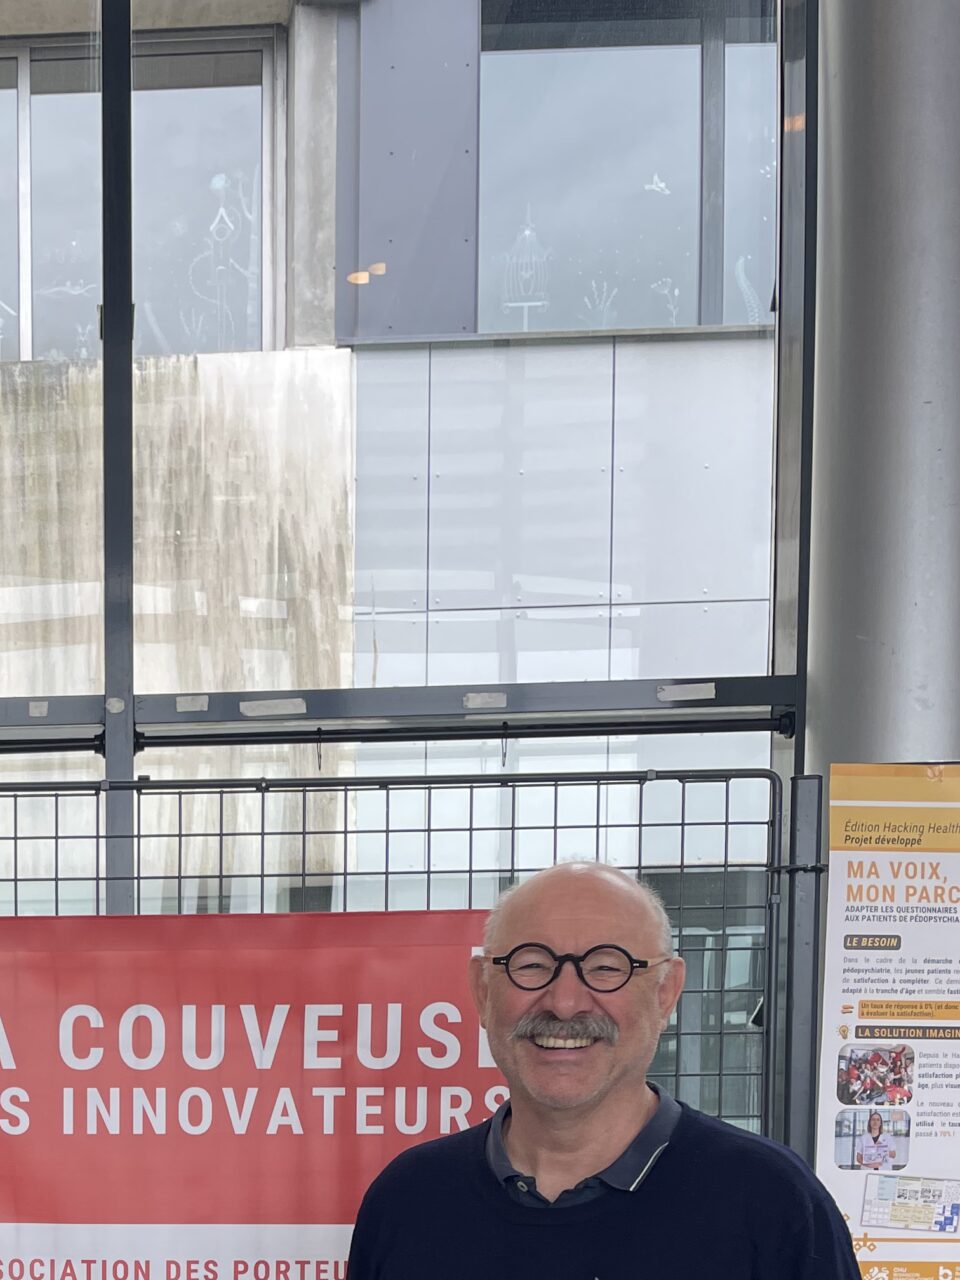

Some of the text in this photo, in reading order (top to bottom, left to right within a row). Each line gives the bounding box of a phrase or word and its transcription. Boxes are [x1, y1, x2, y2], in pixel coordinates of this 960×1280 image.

[844, 819, 960, 836] Édition Hacking Health
[844, 835, 872, 846] Projet
[847, 861, 947, 884] MA VOIX,
[846, 884, 960, 903] MON PARC
[896, 906, 958, 914] QUESTIONNAIRES
[846, 938, 898, 947] LE BESOIN
[842, 987, 862, 995] adapté
[858, 1029, 871, 1037] LA
[873, 1029, 923, 1037] SOLUTION
[63, 1085, 511, 1136] INNOVATEURS
